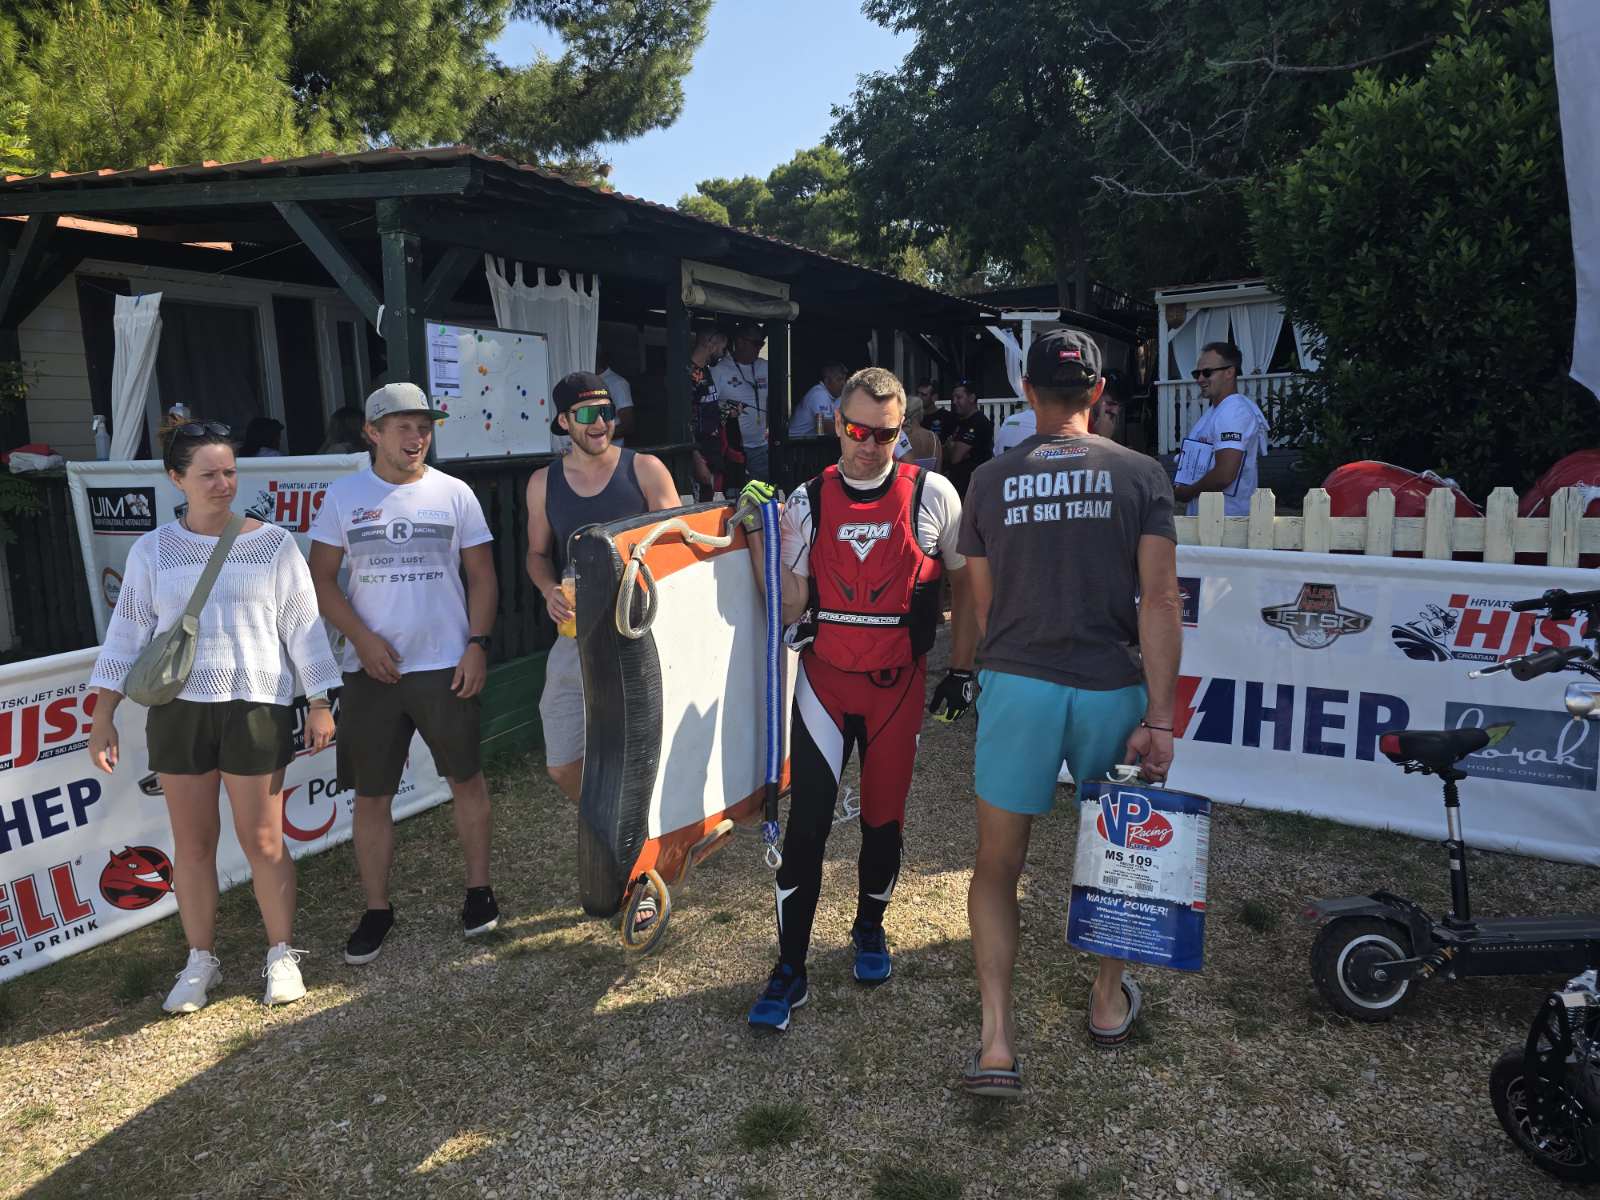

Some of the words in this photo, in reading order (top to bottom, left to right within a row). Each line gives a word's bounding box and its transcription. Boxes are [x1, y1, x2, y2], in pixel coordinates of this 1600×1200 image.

[1004, 469, 1113, 502] CROATIA
[91, 496, 125, 518] UIM
[1004, 506, 1028, 526] JET
[1033, 503, 1060, 521] SKI
[1065, 501, 1112, 520] TEAM
[393, 522, 408, 539] R
[390, 571, 444, 582] SYSTEM
[1267, 612, 1313, 627] JET
[1320, 614, 1366, 630] SKI
[1456, 652, 1495, 661] CROATIAN
[31, 690, 53, 702] JET
[56, 685, 76, 697] SKI
[1242, 681, 1410, 761] HEP
[54, 747, 67, 755] SKI
[1466, 764, 1505, 774] HOME
[1508, 769, 1573, 780] CONCEPT
[0, 777, 102, 855] HEP
[1099, 791, 1152, 849] VP
[1129, 825, 1173, 845] Racing
[1104, 849, 1124, 862] MS
[1128, 854, 1153, 868] 109
[1122, 900, 1168, 917] POWER!
[35, 920, 98, 951] DRINK
